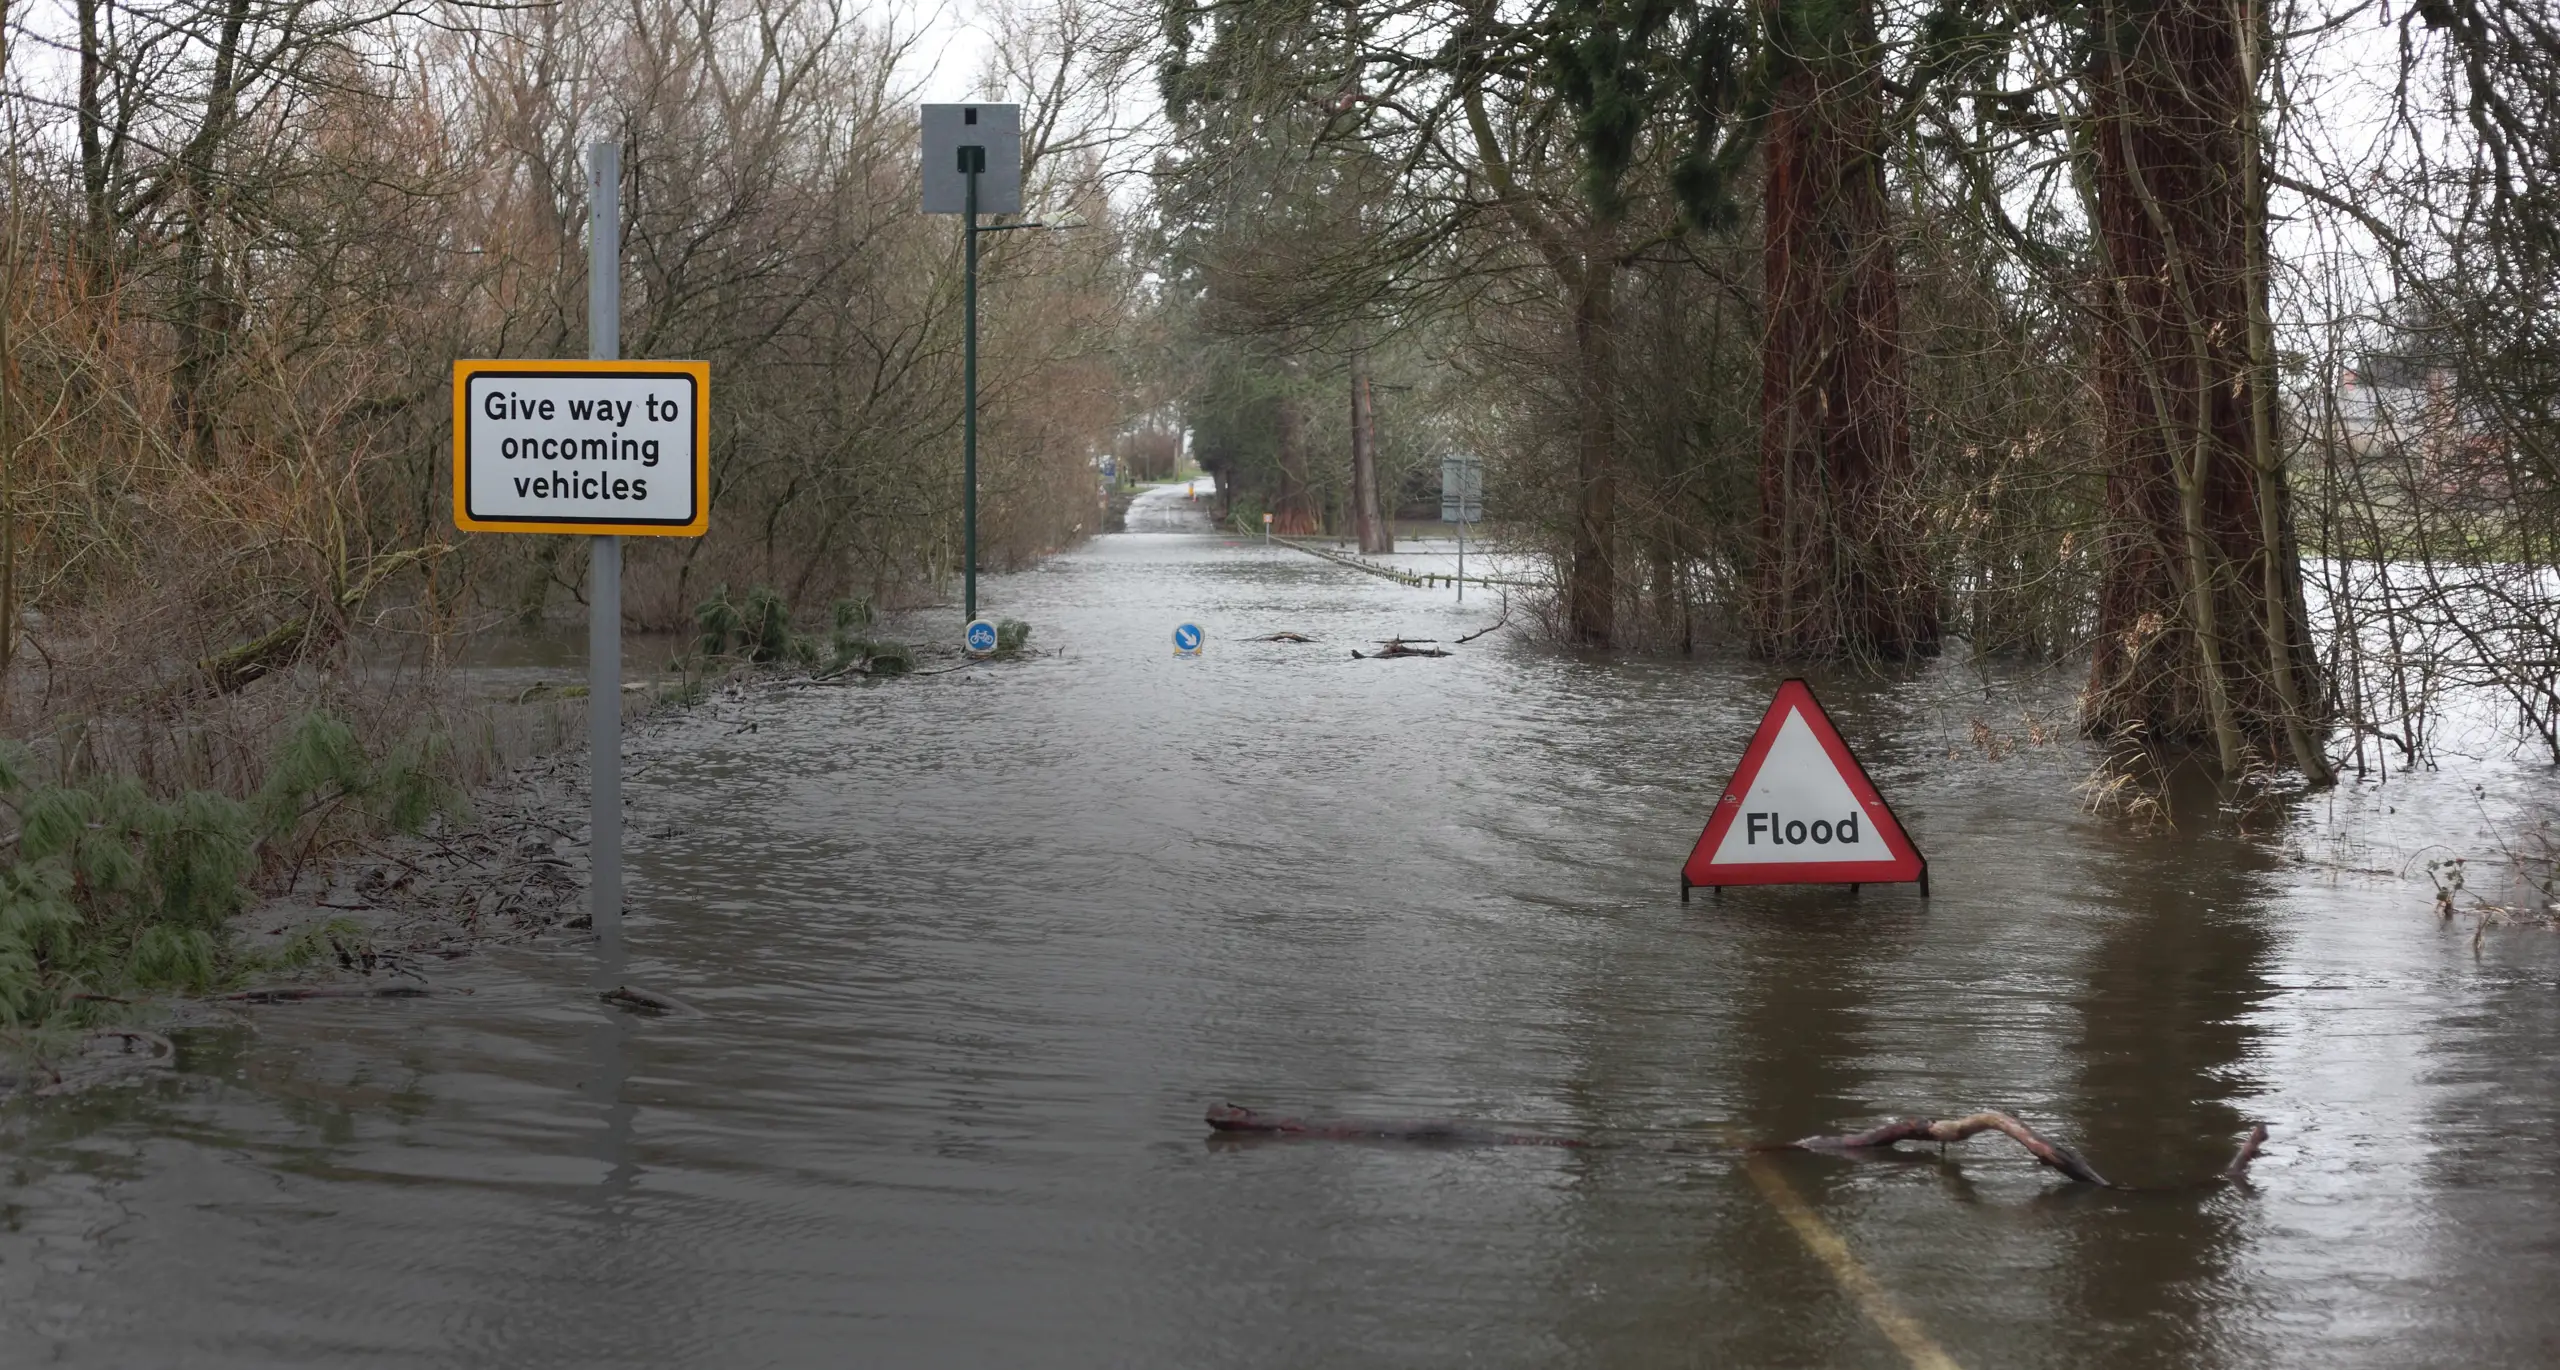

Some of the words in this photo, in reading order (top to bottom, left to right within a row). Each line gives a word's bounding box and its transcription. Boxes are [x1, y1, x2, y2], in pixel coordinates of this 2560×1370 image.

[484, 391, 556, 421] Give
[568, 399, 633, 428] way
[645, 393, 679, 422] to
[501, 431, 660, 468] oncoming
[513, 470, 648, 501] vehicles
[1746, 811, 1860, 846] Flood
